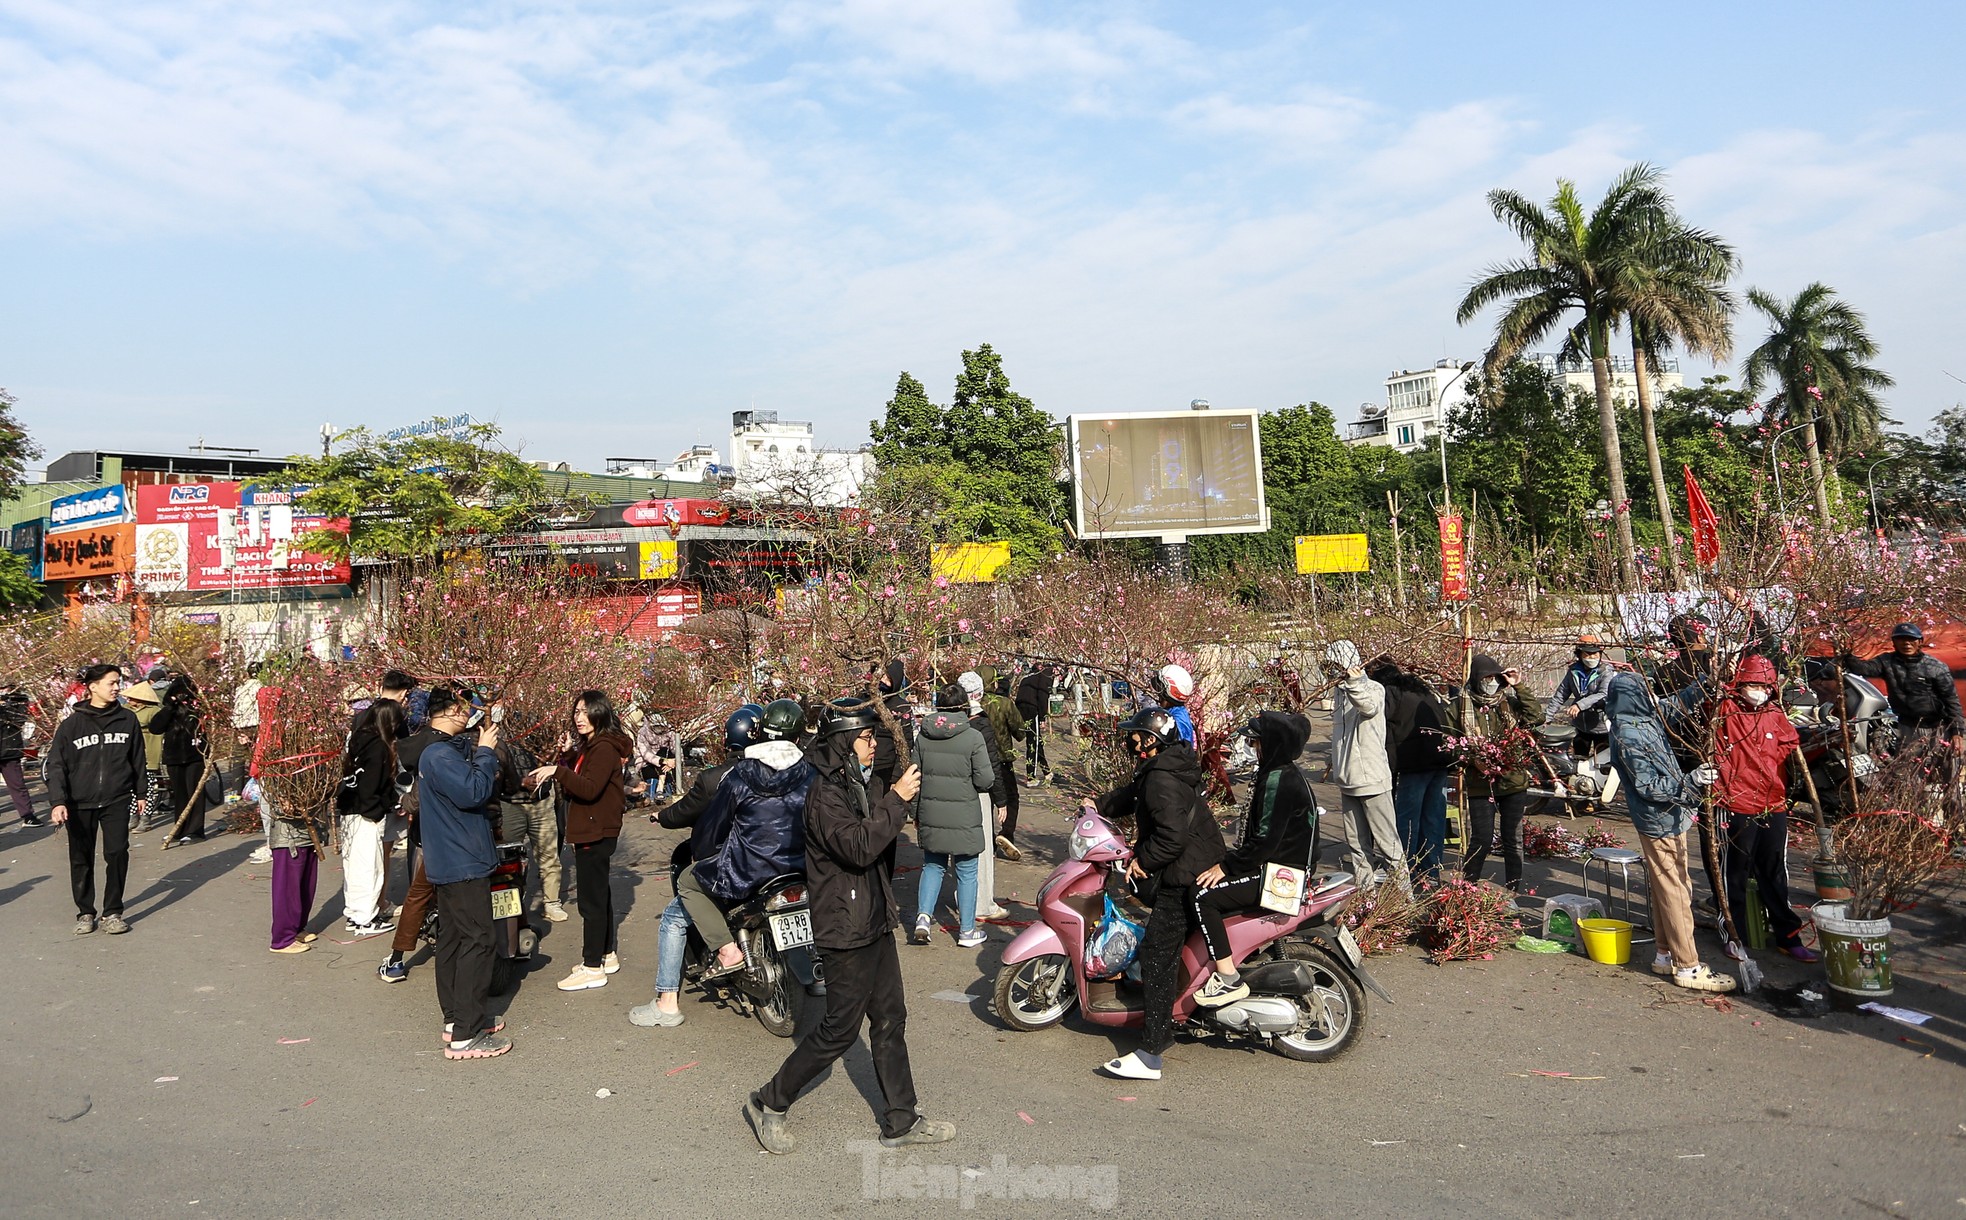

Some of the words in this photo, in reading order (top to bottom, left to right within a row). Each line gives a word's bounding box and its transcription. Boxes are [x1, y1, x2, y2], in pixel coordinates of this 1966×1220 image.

[171, 487, 208, 500] NPG
[140, 572, 181, 582] PRIME
[73, 734, 99, 750] VAG
[103, 733, 129, 744] RAT
[493, 891, 515, 905] 9-F1
[781, 928, 809, 945] 5147
